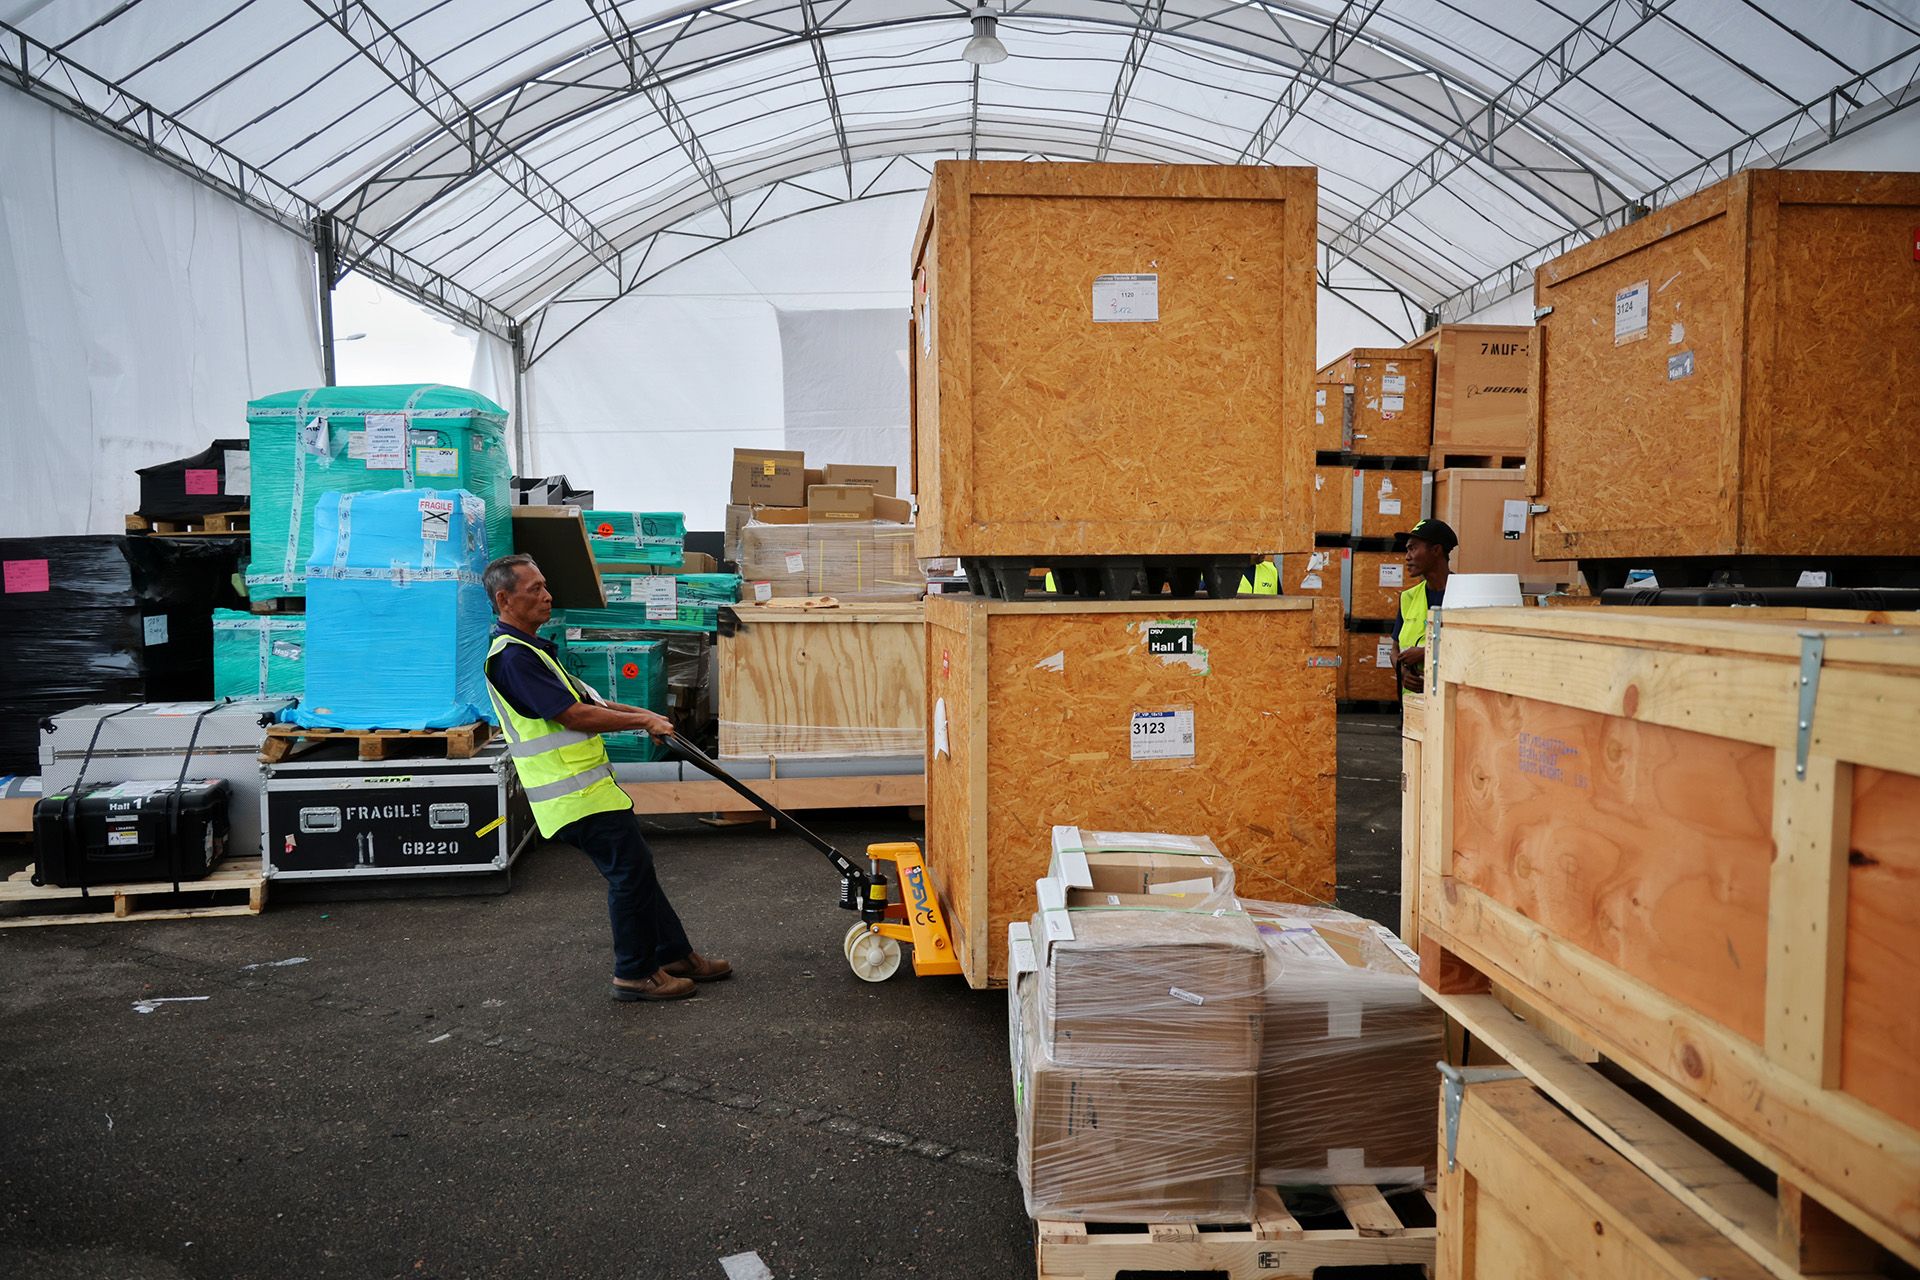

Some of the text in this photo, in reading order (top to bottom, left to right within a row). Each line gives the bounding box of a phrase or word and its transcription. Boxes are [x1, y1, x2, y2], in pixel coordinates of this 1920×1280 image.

[1616, 301, 1633, 315] 3124
[1669, 366, 1683, 378] Hall
[1684, 358, 1691, 374] 1
[427, 436, 436, 445] 2
[420, 501, 452, 511] FRAGILE
[613, 585, 622, 594] 2
[1151, 635, 1187, 652] Hall 1
[290, 649, 299, 660] 2
[1133, 722, 1166, 735] 3123
[109, 798, 142, 811] Hall 1
[346, 804, 422, 820] FRAGILE
[402, 841, 459, 855] GB220
[908, 873, 931, 913] DSV
